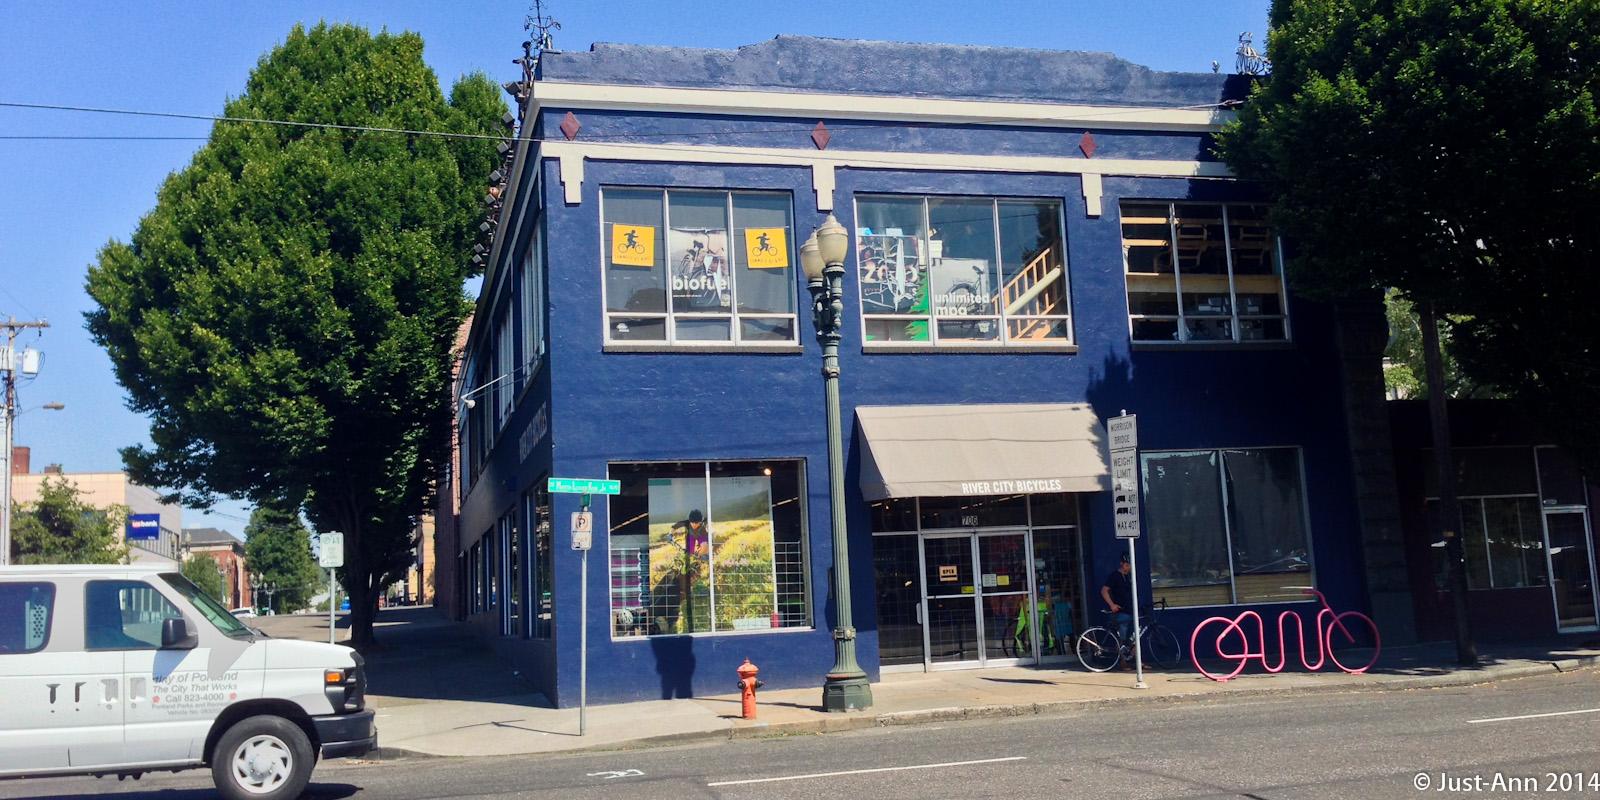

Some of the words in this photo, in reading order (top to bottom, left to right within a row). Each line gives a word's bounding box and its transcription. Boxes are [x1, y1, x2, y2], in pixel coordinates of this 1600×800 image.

[673, 275, 731, 290] biofuel
[935, 293, 990, 304] unlimited
[1111, 421, 1132, 431] MORRISON
[1114, 434, 1130, 444] BRIDGE
[1113, 456, 1133, 466] WEIGHT
[1117, 469, 1131, 478] LIMIT
[962, 482, 991, 494] RIVER
[993, 481, 1014, 493] CITY
[1016, 479, 1062, 492] BICYCLES
[1117, 521, 1127, 530] MAX
[178, 671, 189, 682] of
[153, 685, 168, 693] The
[171, 684, 187, 694] City
[191, 682, 209, 692] That
[211, 683, 237, 691] Works
[165, 694, 182, 703] Call
[184, 693, 224, 702] 823-4000
